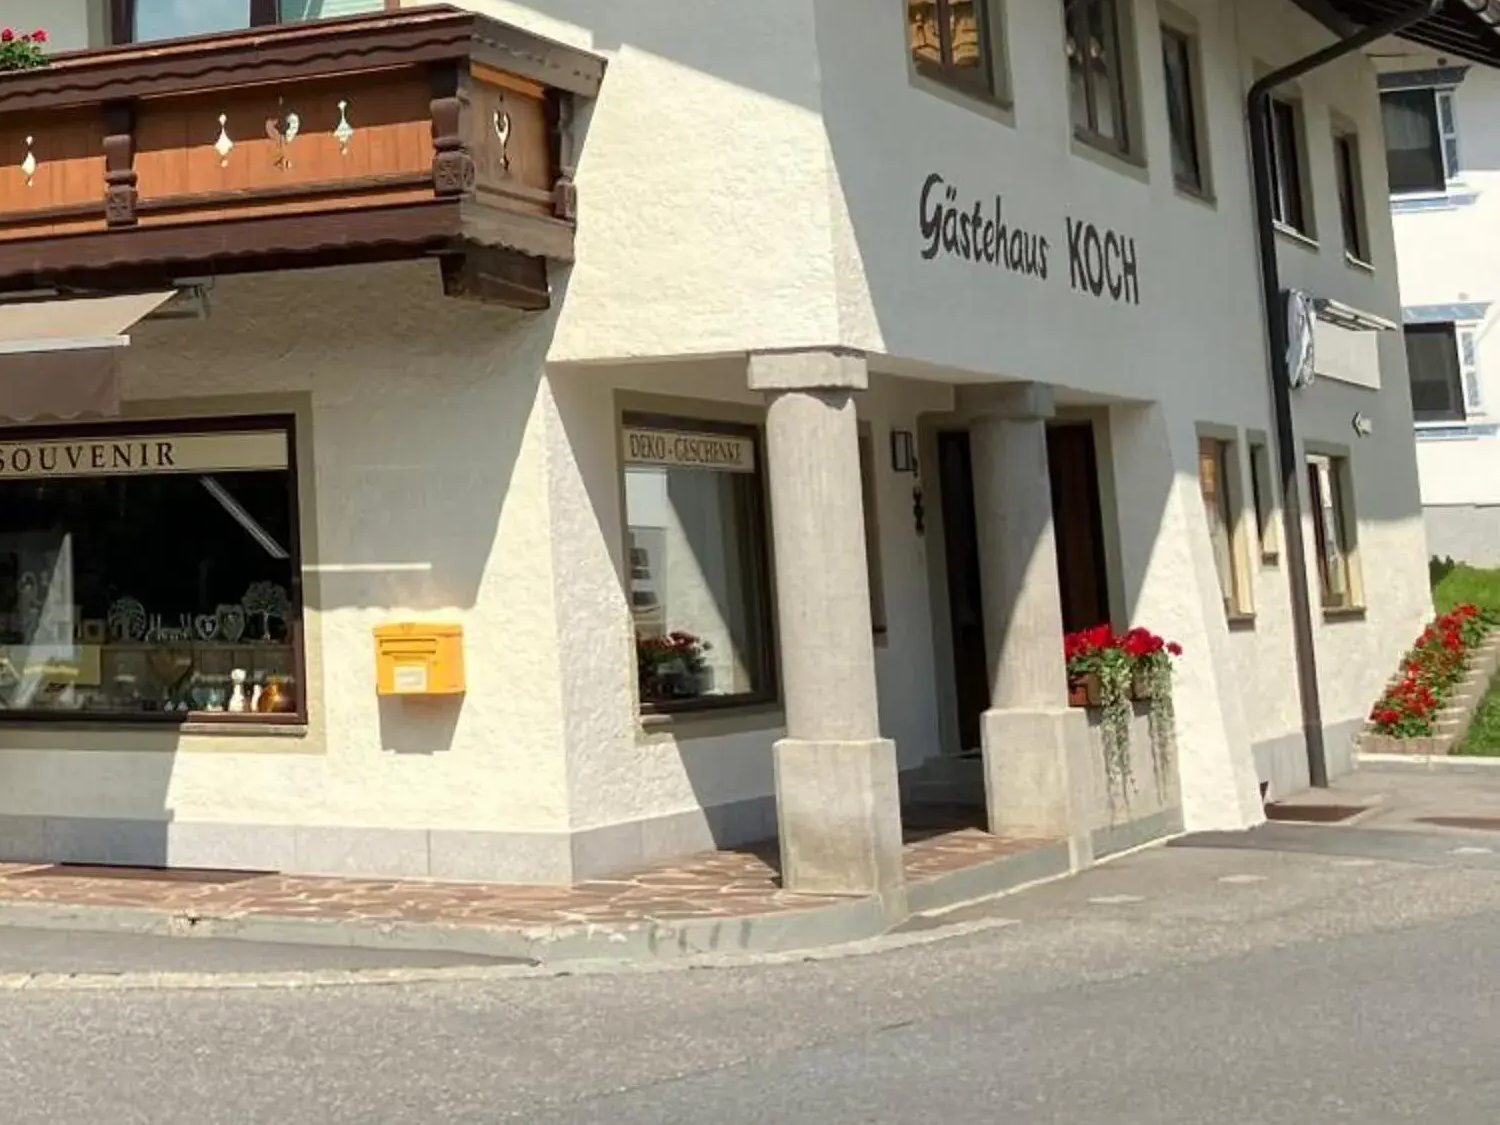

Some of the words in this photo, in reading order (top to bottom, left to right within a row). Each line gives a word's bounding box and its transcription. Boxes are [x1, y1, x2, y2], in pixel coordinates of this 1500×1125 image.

[919, 172, 1049, 280] Gästehaus
[1066, 216, 1139, 306] KOCH
[629, 433, 666, 460] DEKO
[674, 437, 743, 463] GESCHENKE
